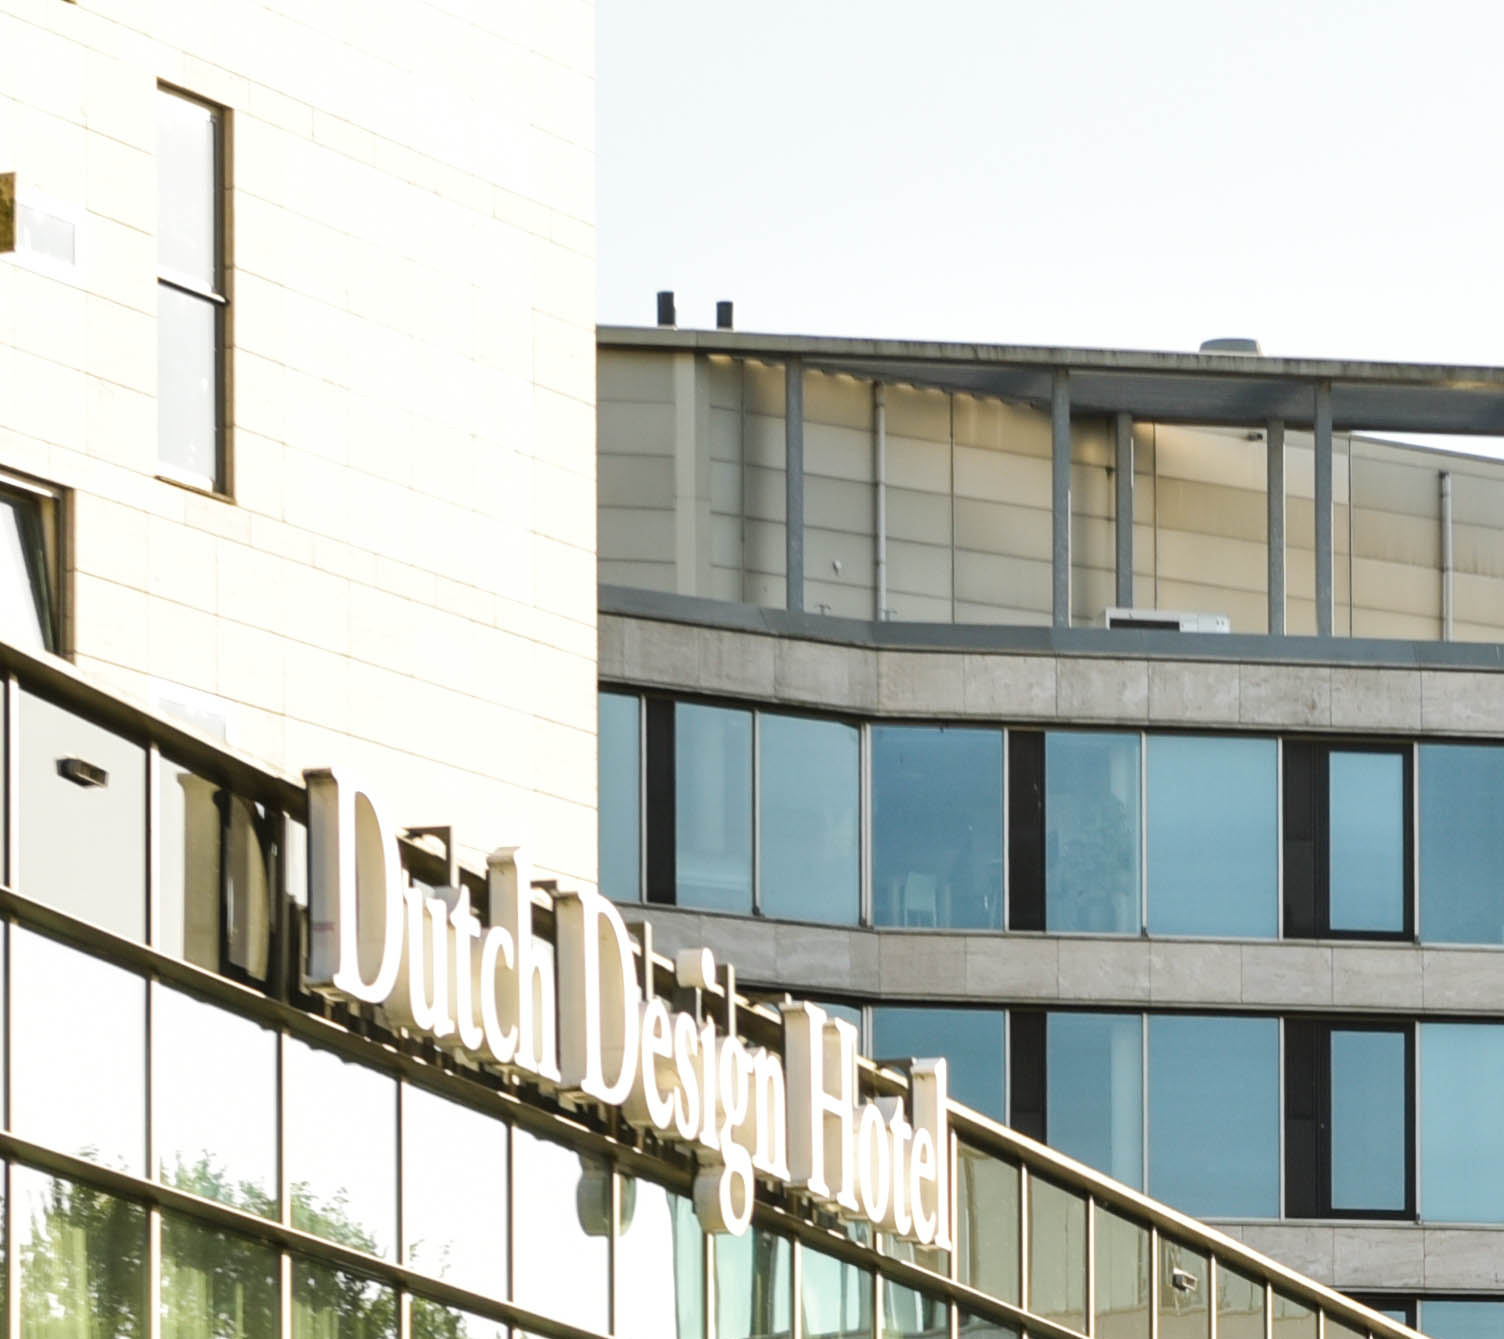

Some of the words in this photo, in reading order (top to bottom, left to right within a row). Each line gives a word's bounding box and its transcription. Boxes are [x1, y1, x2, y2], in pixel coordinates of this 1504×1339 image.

[324, 768, 562, 1083] Dutch
[564, 888, 790, 1237] Design
[796, 998, 952, 1252] Hotel
